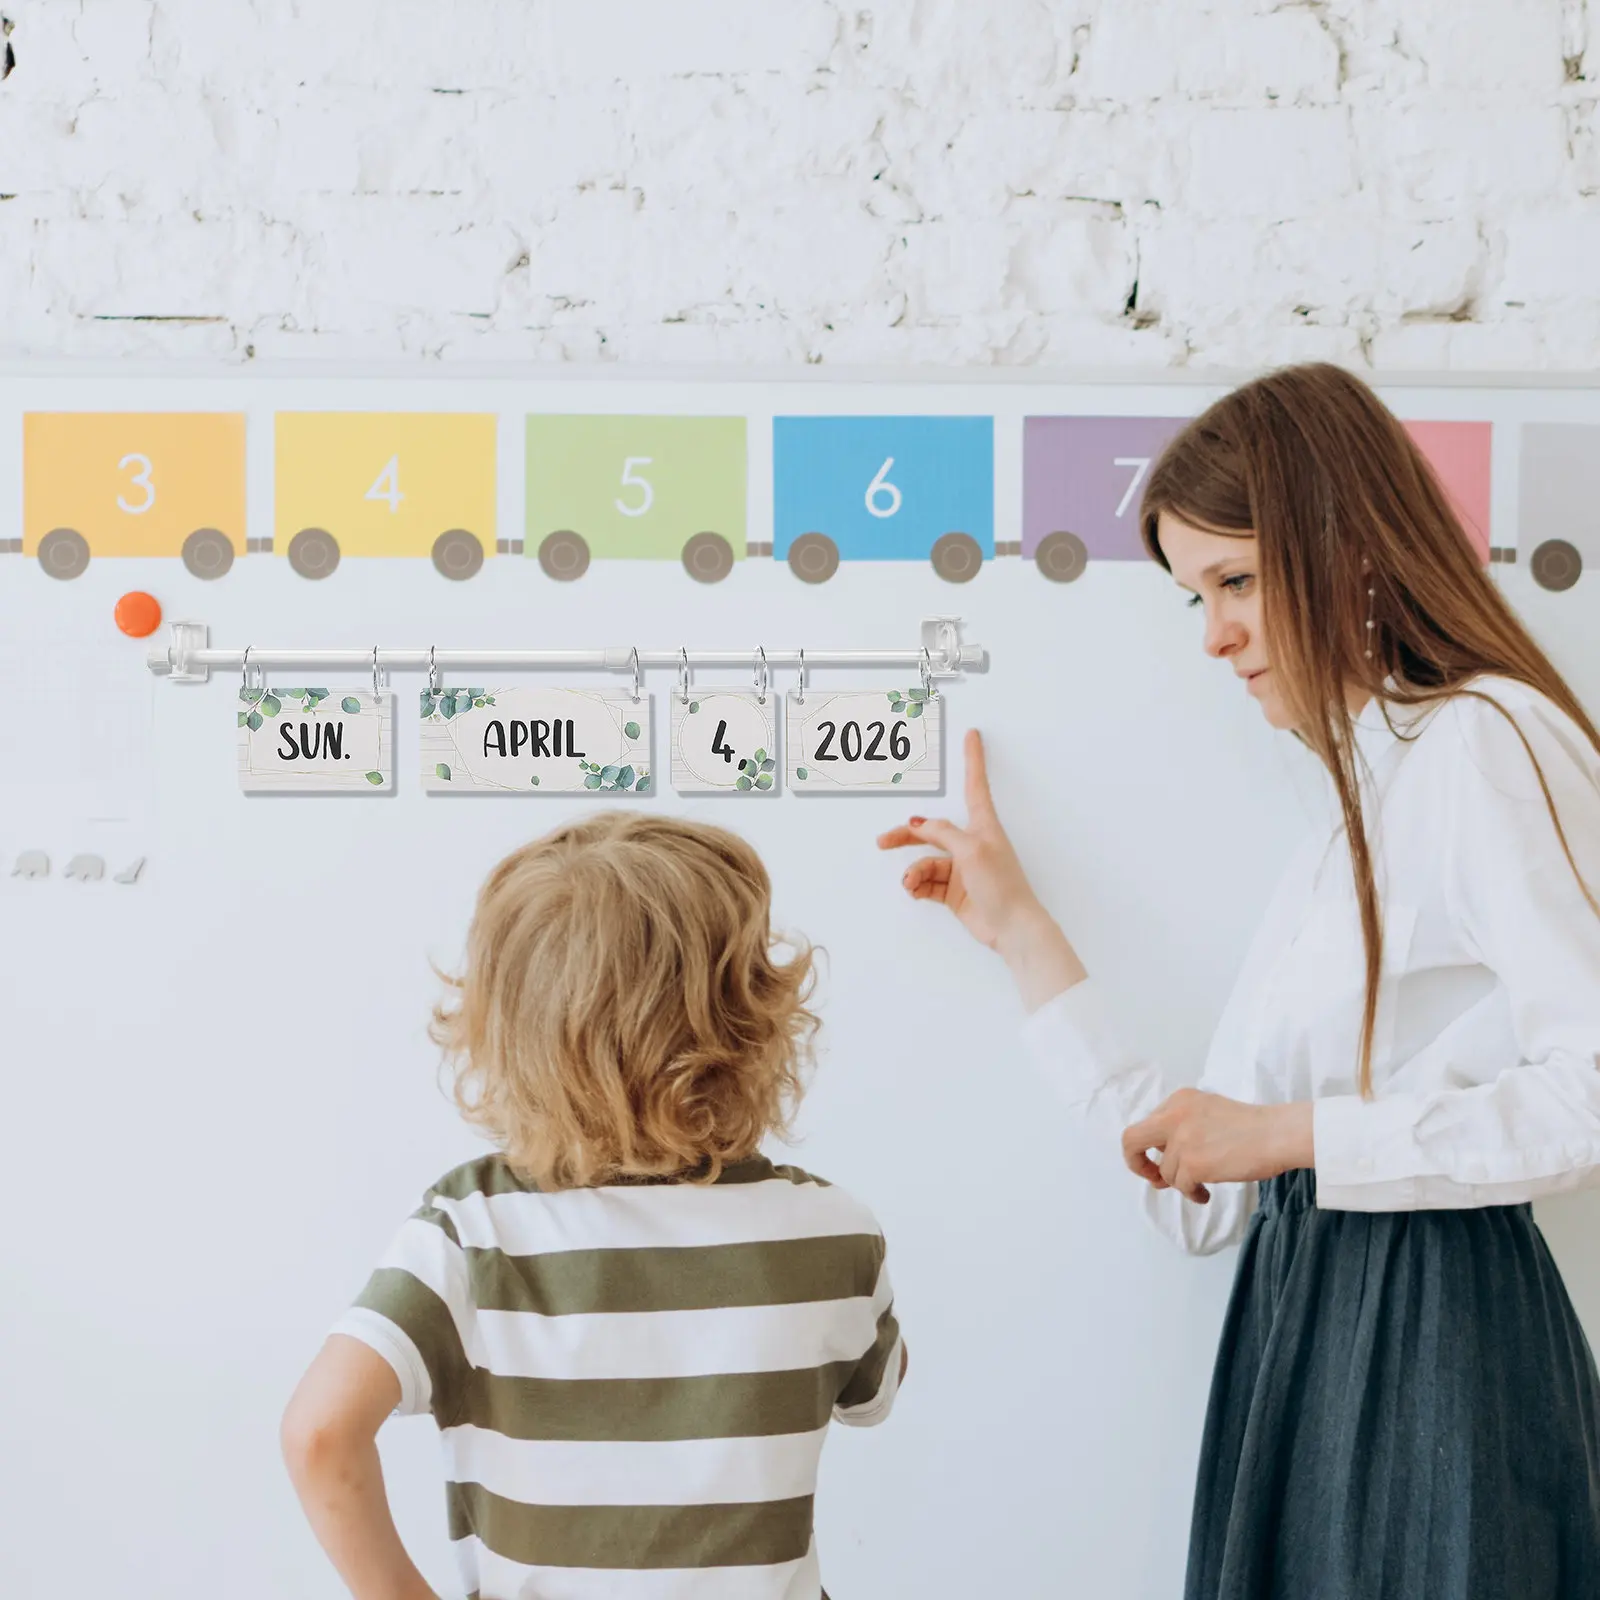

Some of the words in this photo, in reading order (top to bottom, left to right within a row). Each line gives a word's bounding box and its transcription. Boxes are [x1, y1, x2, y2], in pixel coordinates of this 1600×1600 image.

[115, 453, 156, 514] 3
[364, 455, 405, 514] 4
[614, 456, 655, 517] 5
[864, 457, 903, 518] 6
[1113, 457, 1151, 518] 7
[277, 721, 351, 761] SUN.
[484, 719, 586, 759] APRIL
[814, 720, 911, 762] 2026
